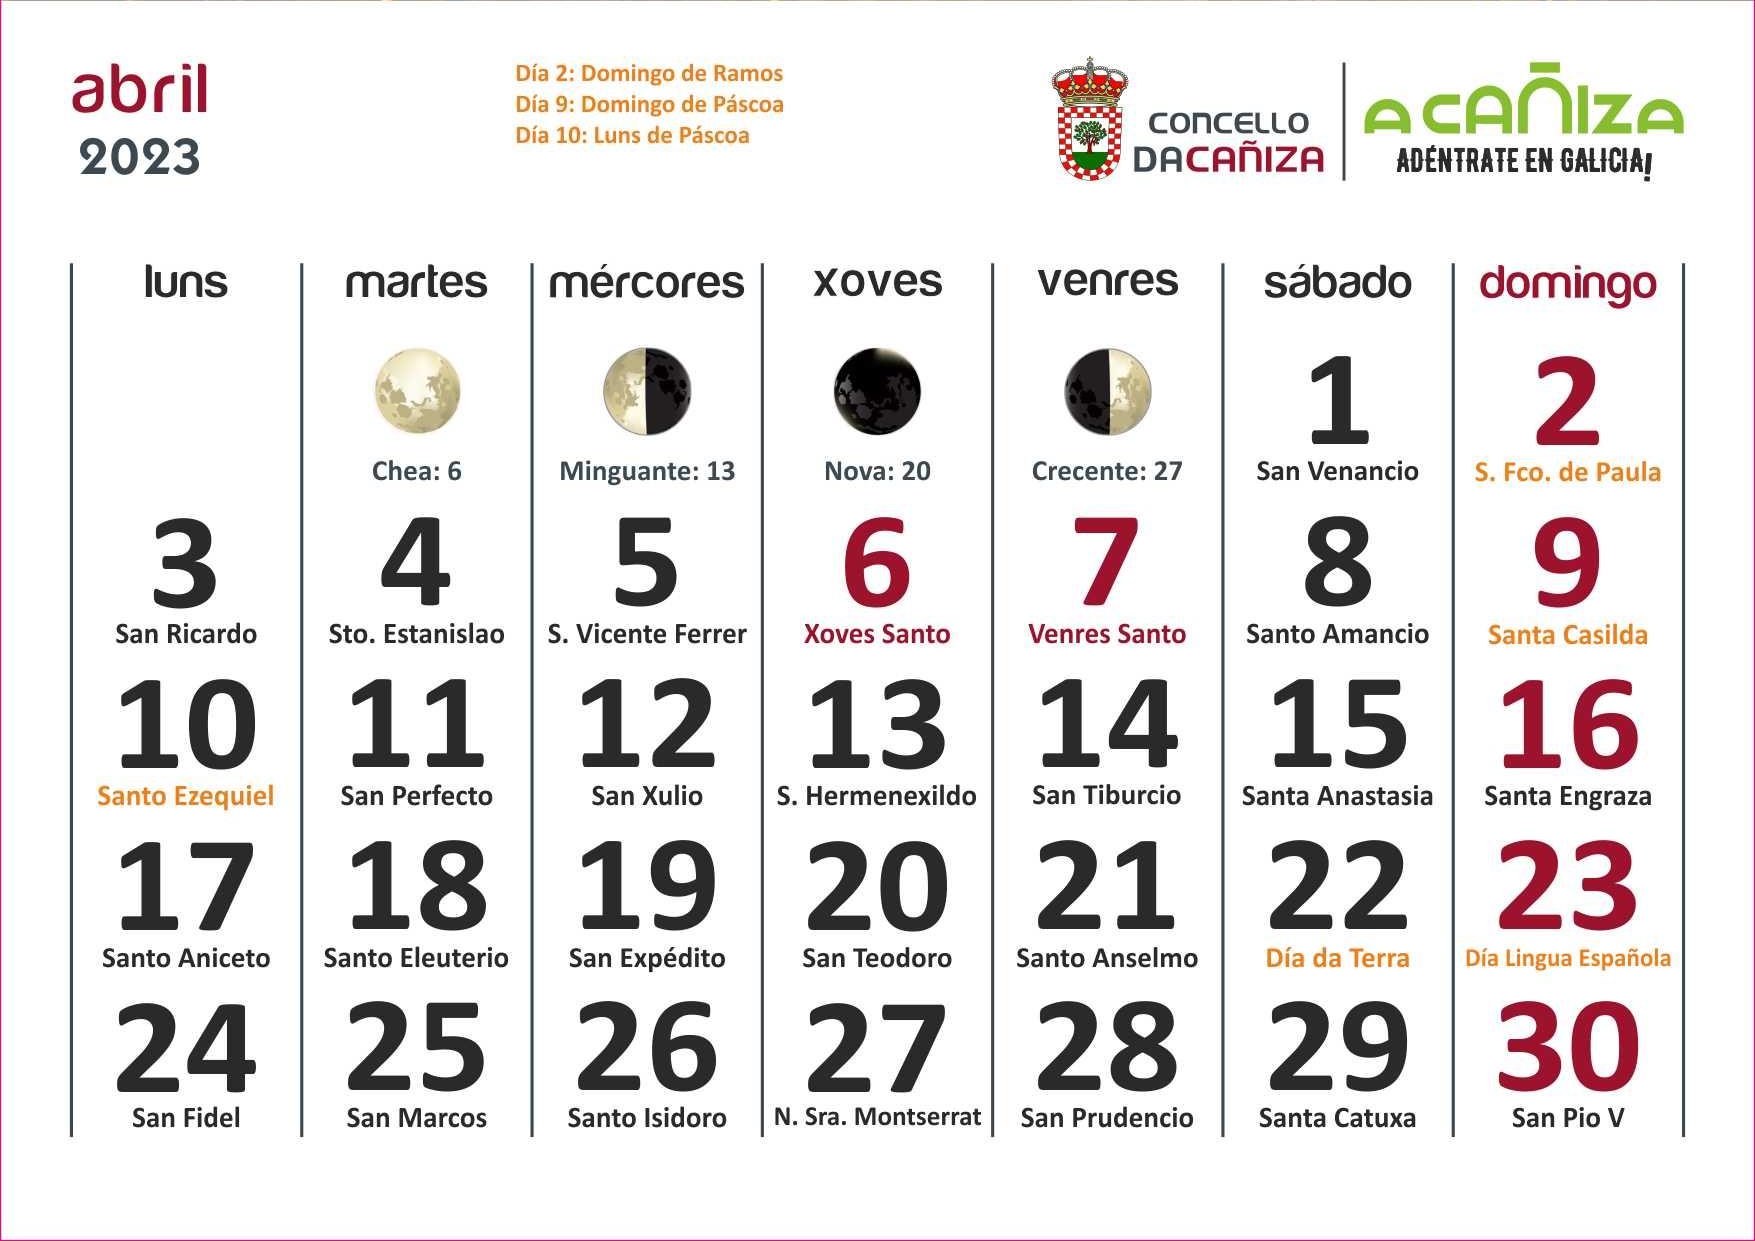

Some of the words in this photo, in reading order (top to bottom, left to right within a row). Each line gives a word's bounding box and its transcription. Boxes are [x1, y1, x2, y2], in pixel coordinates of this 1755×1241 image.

[72, 63, 206, 113] abril
[516, 64, 548, 81] Día
[556, 64, 574, 82] 2:
[582, 64, 675, 86] Domingo
[682, 64, 706, 81] de
[714, 65, 783, 81] Ramos
[516, 95, 548, 112] Día
[556, 96, 574, 112] 9:
[582, 95, 675, 117] Domingo
[682, 95, 706, 112] de
[714, 95, 783, 112] Páscoa
[517, 126, 549, 143] Día
[557, 126, 586, 143] 10:
[595, 127, 640, 143] Luns
[648, 126, 672, 144] de
[680, 126, 749, 144] Páscoa
[1149, 112, 1309, 134] CONCELLO
[80, 138, 199, 175] 2023
[1397, 145, 1518, 172] ADÉNTRATE
[1525, 148, 1553, 172] EN
[1560, 147, 1652, 182] GALICIA!
[146, 264, 228, 298] luns
[346, 264, 487, 298] martes
[550, 264, 744, 298] mércores
[814, 268, 942, 296] xoves
[1038, 269, 1178, 296] venres
[1265, 264, 1411, 298] sábado
[1480, 265, 1657, 309] domingo
[1311, 356, 1369, 444] 1
[1536, 356, 1599, 445] 2
[373, 460, 439, 480] Chea:
[448, 461, 461, 480] 6
[561, 461, 698, 485] Minguante:
[708, 461, 735, 480] 13
[826, 461, 893, 480] Nova:
[903, 461, 930, 480] 20
[1033, 461, 1145, 480] Crecente:
[1155, 461, 1182, 480] 27
[1257, 461, 1299, 480] San
[1308, 461, 1418, 480] Venancio
[1476, 462, 1494, 482] S.
[1505, 462, 1550, 482] Fco.
[1559, 461, 1588, 481] de
[1597, 461, 1661, 482] Paula
[154, 518, 216, 609] 3
[381, 517, 450, 606] 4
[616, 517, 677, 607] 5
[845, 517, 909, 608] 6
[1075, 517, 1138, 606] 7
[1305, 516, 1371, 607] 8
[1535, 517, 1599, 608] 9
[116, 624, 158, 643] San
[168, 623, 257, 643] Ricardo
[329, 624, 375, 644] Sto.
[385, 622, 504, 644] Estanislao
[548, 624, 568, 643] S.
[576, 623, 666, 643] Vicente
[676, 624, 747, 643] Ferrer
[804, 624, 874, 643] Xoves
[883, 624, 950, 644] Santo
[1029, 624, 1110, 643] Venres
[1118, 624, 1186, 643] Santo
[1247, 624, 1315, 643] Santo
[1323, 623, 1429, 643] Amancio
[1489, 624, 1555, 644] Santa
[1564, 624, 1647, 645] Casilda
[121, 679, 255, 770] 10
[352, 679, 484, 767] 11
[582, 678, 715, 767] 12
[812, 679, 945, 770] 13
[1042, 679, 1178, 768] 14
[1274, 679, 1406, 769] 15
[1503, 679, 1638, 770] 16
[98, 786, 166, 806] Santo
[175, 784, 273, 810] Ezequiel
[341, 786, 383, 805] San
[393, 784, 492, 806] Perfecto
[592, 786, 634, 805] San
[643, 785, 702, 805] Xulio
[778, 786, 797, 805] S.
[807, 784, 976, 806] Hermenexildo
[1033, 785, 1075, 804] San
[1083, 784, 1181, 804] Tiburcio
[1243, 786, 1308, 806] Santa
[1317, 785, 1432, 805] Anastasia
[1485, 786, 1551, 806] Santa
[1561, 786, 1651, 810] Engraza
[121, 842, 253, 931] 17
[352, 840, 486, 931] 18
[582, 840, 715, 931] 19
[808, 841, 947, 932] 20
[1038, 840, 1174, 929] 21
[1270, 840, 1407, 929] 22
[1499, 840, 1636, 931] 23
[103, 948, 170, 968] Santo
[178, 947, 270, 967] Aniceto
[324, 948, 392, 967] Santo
[401, 946, 508, 967] Eleuterio
[570, 948, 611, 967] San
[621, 947, 725, 972] Expédito
[803, 948, 845, 967] San
[853, 947, 952, 968] Teodoro
[1017, 948, 1085, 967] Santo
[1093, 947, 1198, 967] Anselmo
[1267, 947, 1304, 968] Día
[1313, 947, 1341, 968] da
[1349, 948, 1409, 968] Terra
[1466, 948, 1498, 967] Día
[1506, 949, 1572, 971] Lingua
[1580, 948, 1671, 970] Española
[117, 1003, 256, 1092] 24
[348, 1001, 484, 1092] 25
[578, 1001, 716, 1092] 26
[808, 1003, 945, 1092] 27
[1038, 1001, 1177, 1092] 28
[1270, 1001, 1407, 1092] 29
[1499, 1001, 1638, 1092] 30
[133, 1108, 174, 1128] San
[185, 1106, 239, 1127] Fidel
[347, 1108, 389, 1128] San
[399, 1108, 486, 1128] Marcos
[568, 1108, 636, 1128] Santo
[645, 1106, 726, 1128] Isidoro
[775, 1107, 797, 1125] N.
[806, 1107, 846, 1125] Sra.
[855, 1107, 981, 1125] Montserrat
[1022, 1108, 1063, 1127] San
[1073, 1106, 1193, 1127] Prudencio
[1260, 1108, 1326, 1128] Santa
[1335, 1108, 1415, 1127] Catuxa
[1513, 1108, 1554, 1127] San
[1564, 1107, 1600, 1128] Pio
[1608, 1108, 1624, 1127] V
